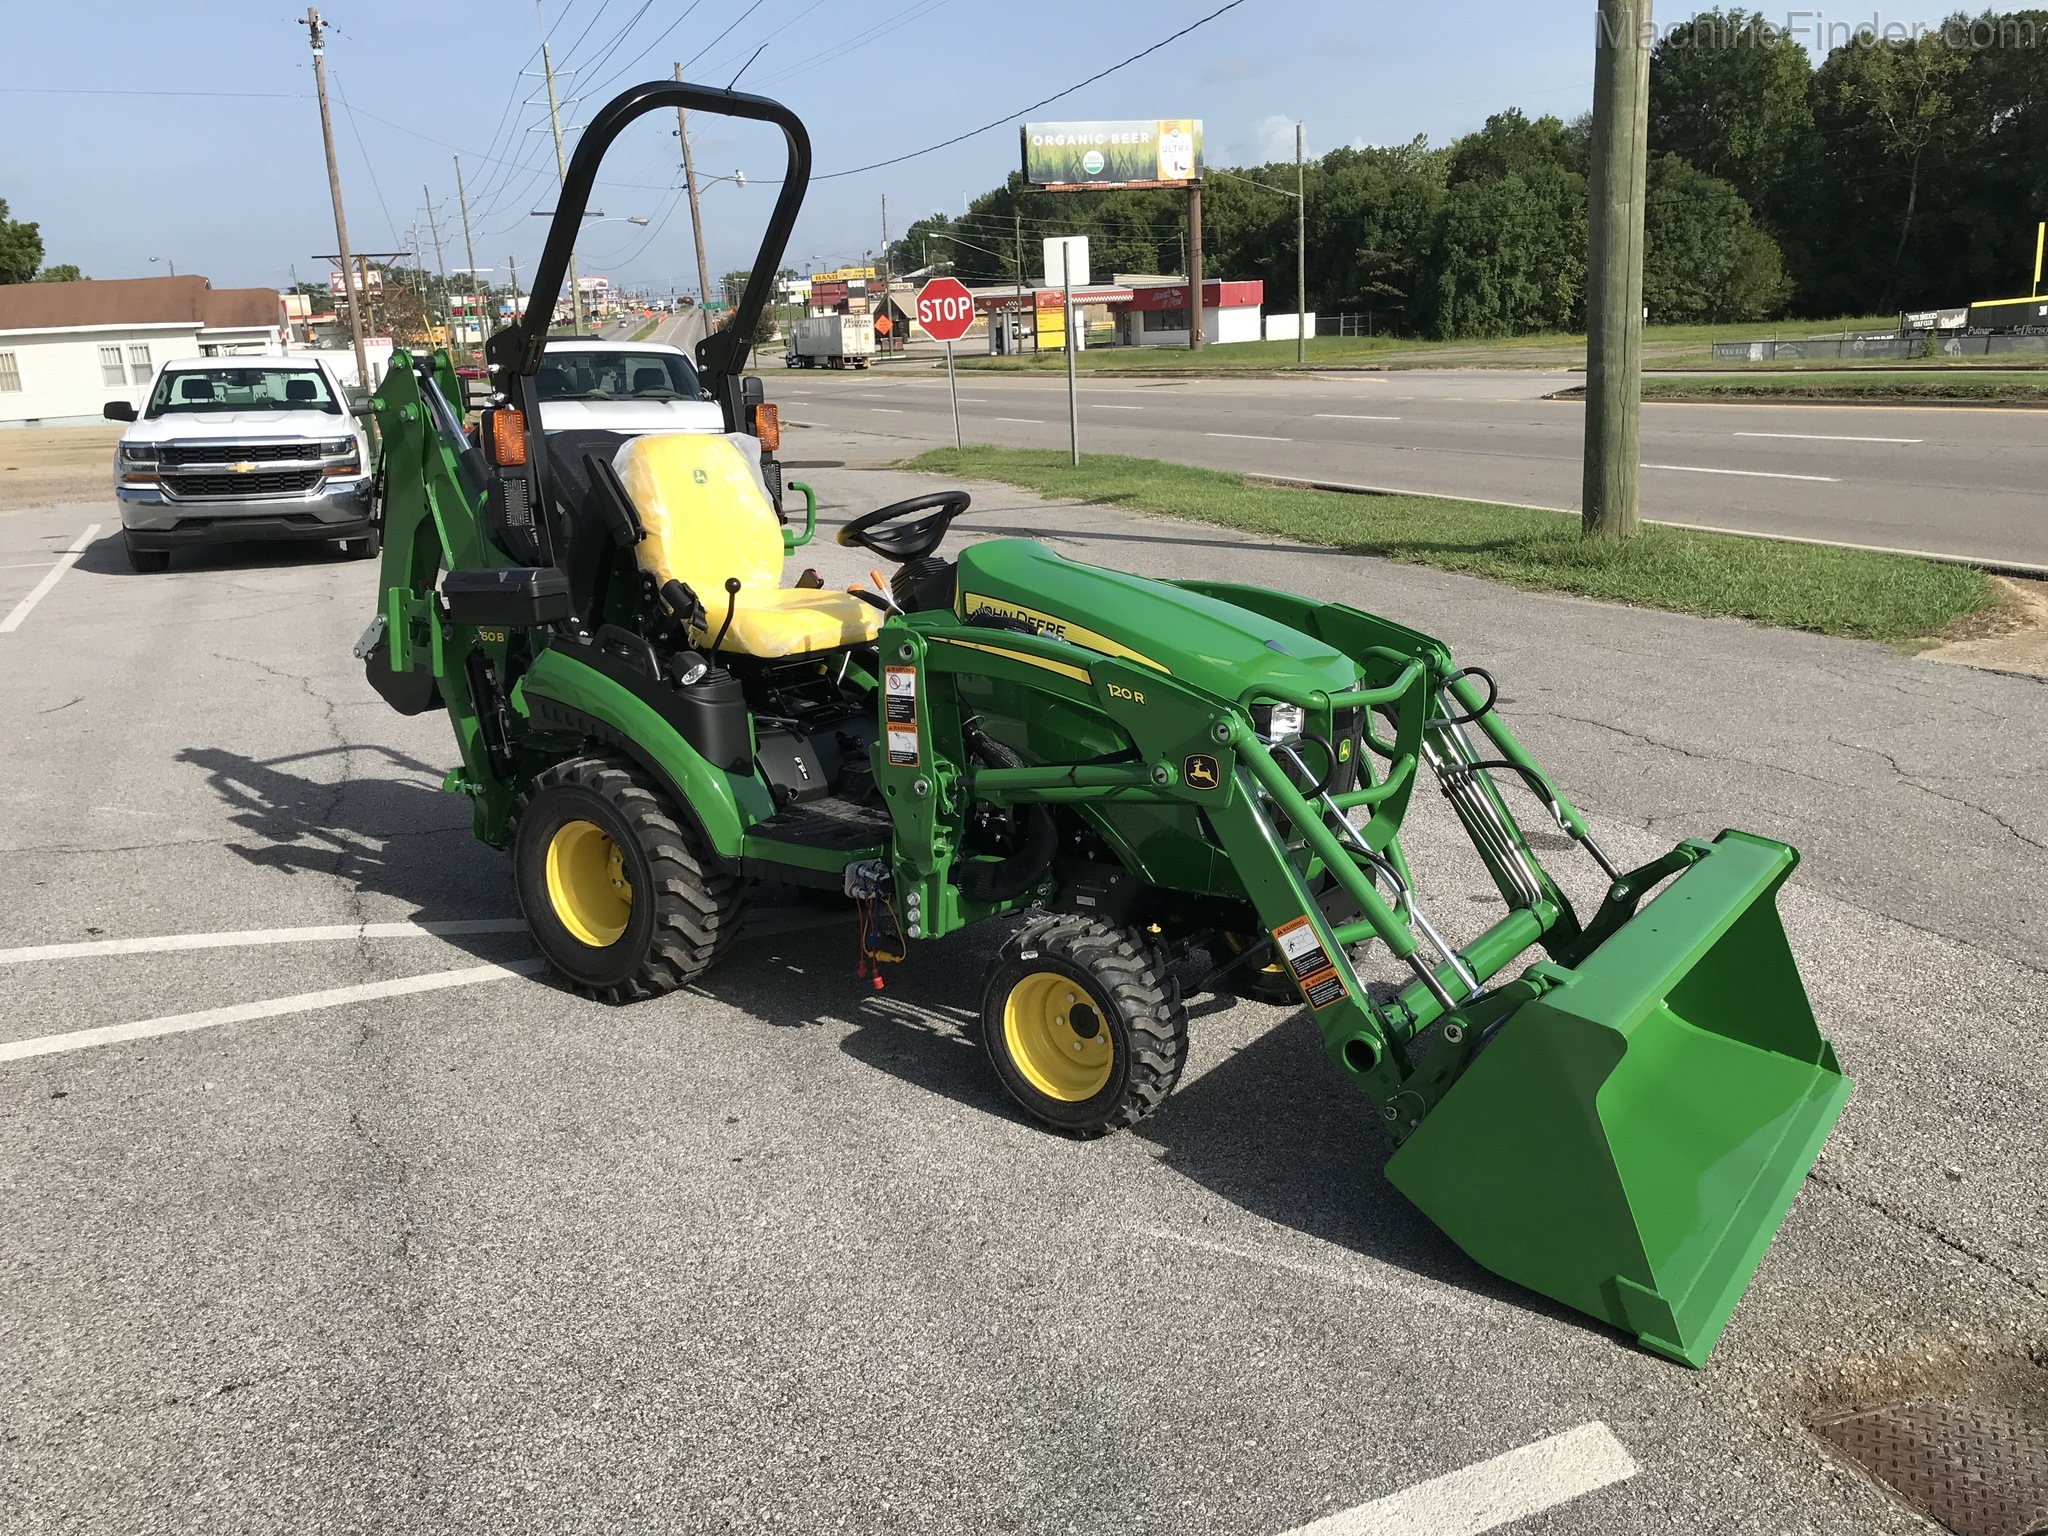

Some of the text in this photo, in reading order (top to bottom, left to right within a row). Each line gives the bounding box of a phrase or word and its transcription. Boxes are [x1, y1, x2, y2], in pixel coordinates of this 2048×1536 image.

[1032, 132, 1150, 147] ORGANIC BEER
[1162, 144, 1190, 153] ULTRA
[919, 296, 971, 323] STOP
[478, 631, 505, 642] 60 B
[1106, 683, 1146, 705] 120 R
[893, 725, 916, 733] WARNING
[1282, 919, 1305, 933] WARNING
[1311, 971, 1334, 985] WARNING
